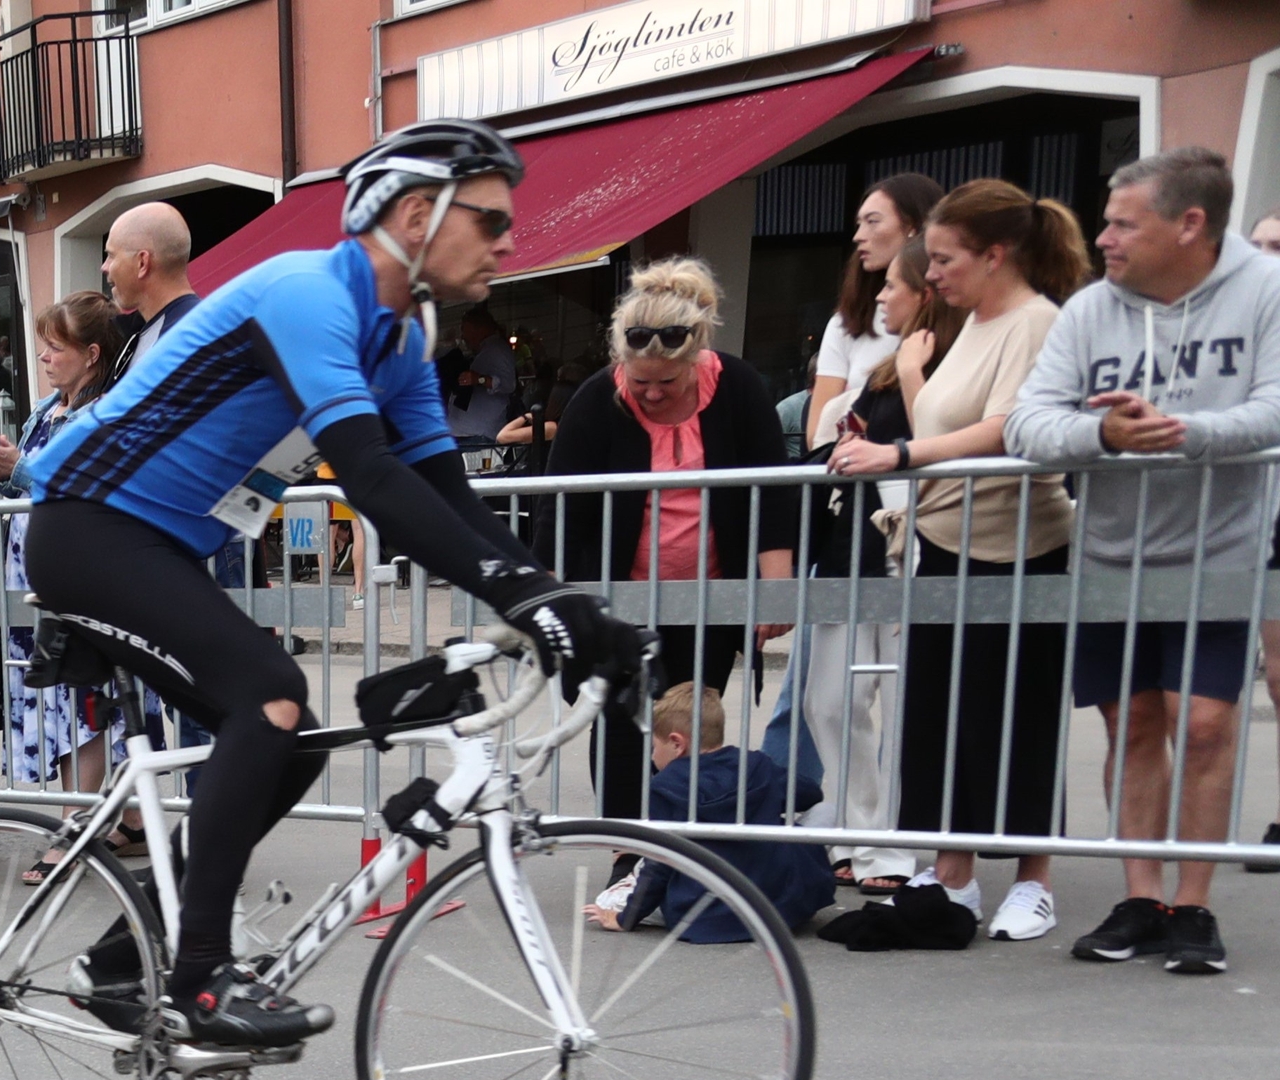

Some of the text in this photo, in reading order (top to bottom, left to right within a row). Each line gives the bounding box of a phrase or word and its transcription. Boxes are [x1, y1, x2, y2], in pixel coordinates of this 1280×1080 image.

[551, 8, 734, 92] Sjöglimten
[654, 37, 734, 72] café & kök
[1088, 337, 1245, 394] GANT
[289, 517, 314, 548] VR
